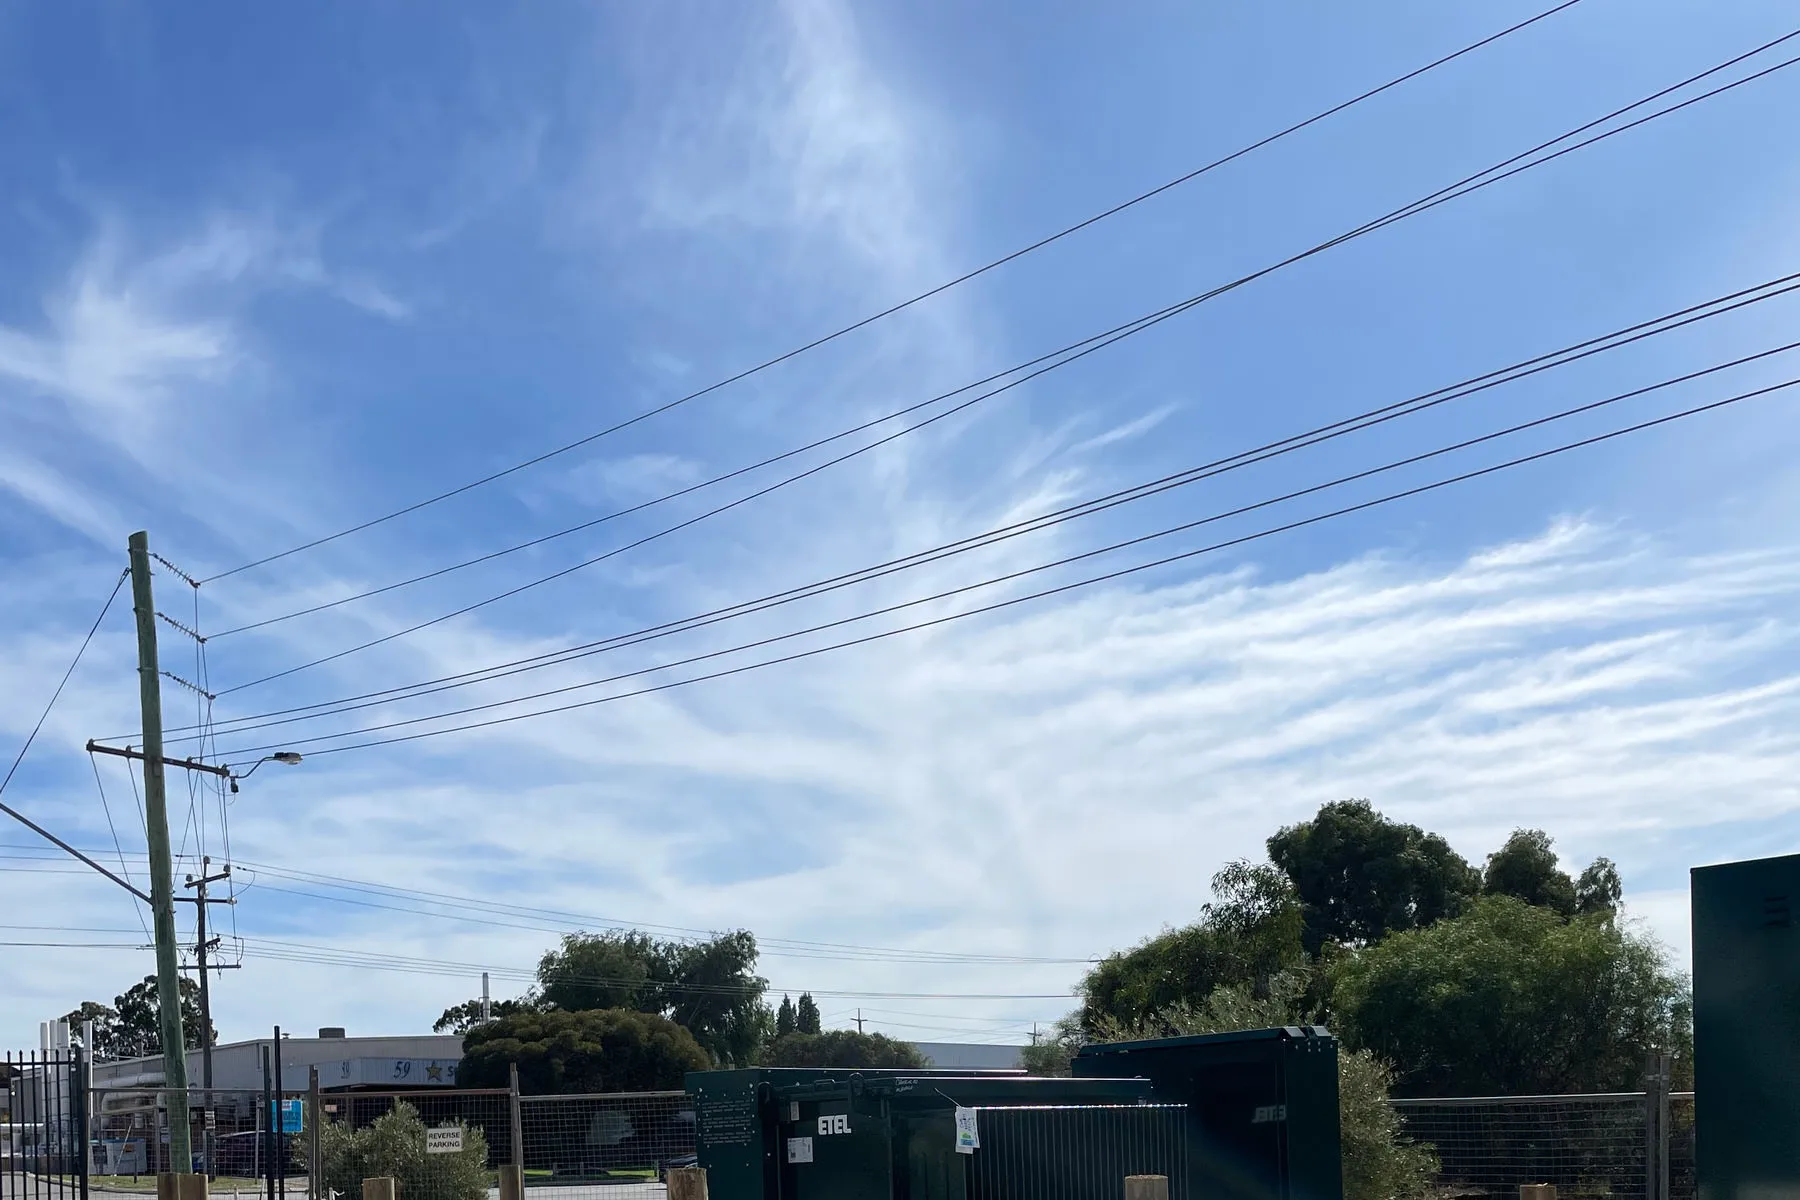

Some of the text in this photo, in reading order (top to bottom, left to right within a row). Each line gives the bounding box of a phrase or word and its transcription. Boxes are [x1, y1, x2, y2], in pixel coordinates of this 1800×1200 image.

[393, 1061, 411, 1079] 59
[818, 1114, 852, 1136] ETEL
[428, 1132, 461, 1140] REVERSE
[428, 1140, 460, 1148] PARKING
